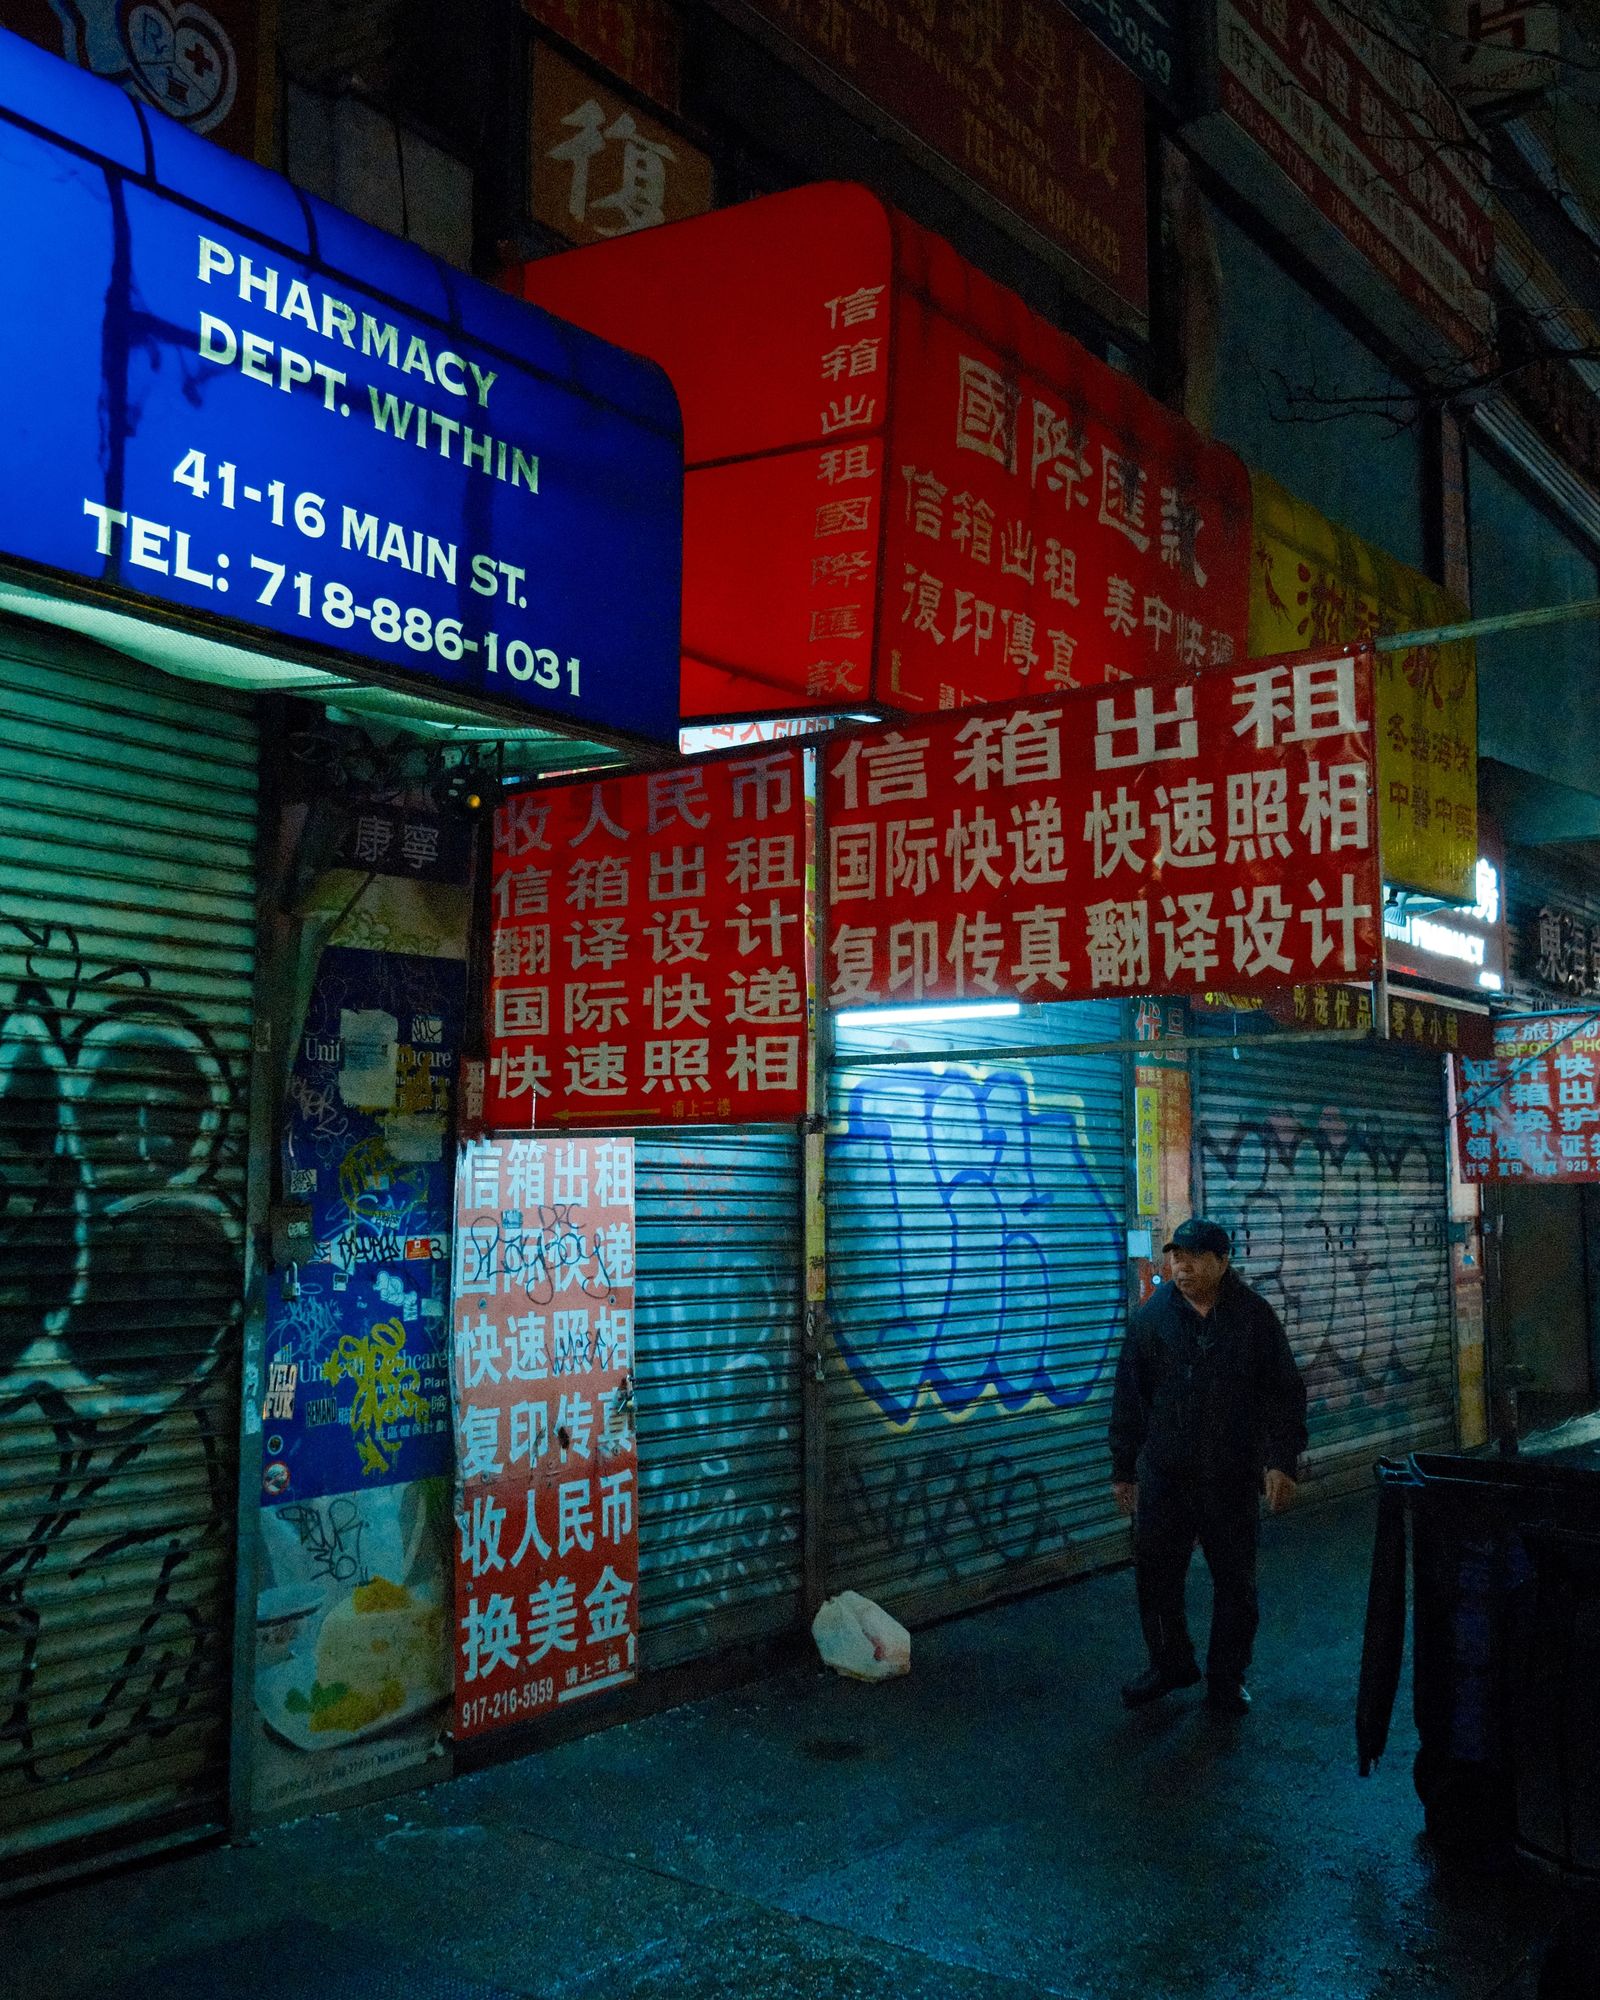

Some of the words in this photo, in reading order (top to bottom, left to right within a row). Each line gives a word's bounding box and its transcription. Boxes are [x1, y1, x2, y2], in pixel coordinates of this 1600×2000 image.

[197, 234, 498, 408] PHARMACY
[198, 311, 350, 417] DEPT.
[367, 385, 540, 494] WITHIN
[172, 447, 326, 539] 41-16
[341, 504, 458, 586] MAIN
[469, 554, 529, 609] ST.
[900, 464, 1081, 608] 信箱出租
[83, 497, 230, 593] TEL:
[250, 553, 583, 697] 718-886-1031
[831, 658, 1372, 809] 信箱出租
[493, 748, 793, 860] 收人民币
[827, 805, 1068, 905] 国际快递
[1084, 760, 1371, 880] 快速照相
[493, 833, 797, 920] 信箱出租
[492, 902, 802, 977] 翻译设计
[829, 903, 1071, 1005] 复印传真
[1086, 870, 1373, 990] 翻译设计
[494, 964, 803, 1041] 国际快递
[490, 1032, 799, 1101] 快速照相
[460, 1138, 634, 1210] 信箱出租
[456, 1220, 634, 1300] 国际快递
[457, 1306, 633, 1391] 快速照相
[460, 1388, 634, 1482] 复印传真
[460, 1468, 635, 1581] 收人民币
[463, 1564, 634, 1684] 换美金
[463, 1676, 554, 1729] 917-216-5959
